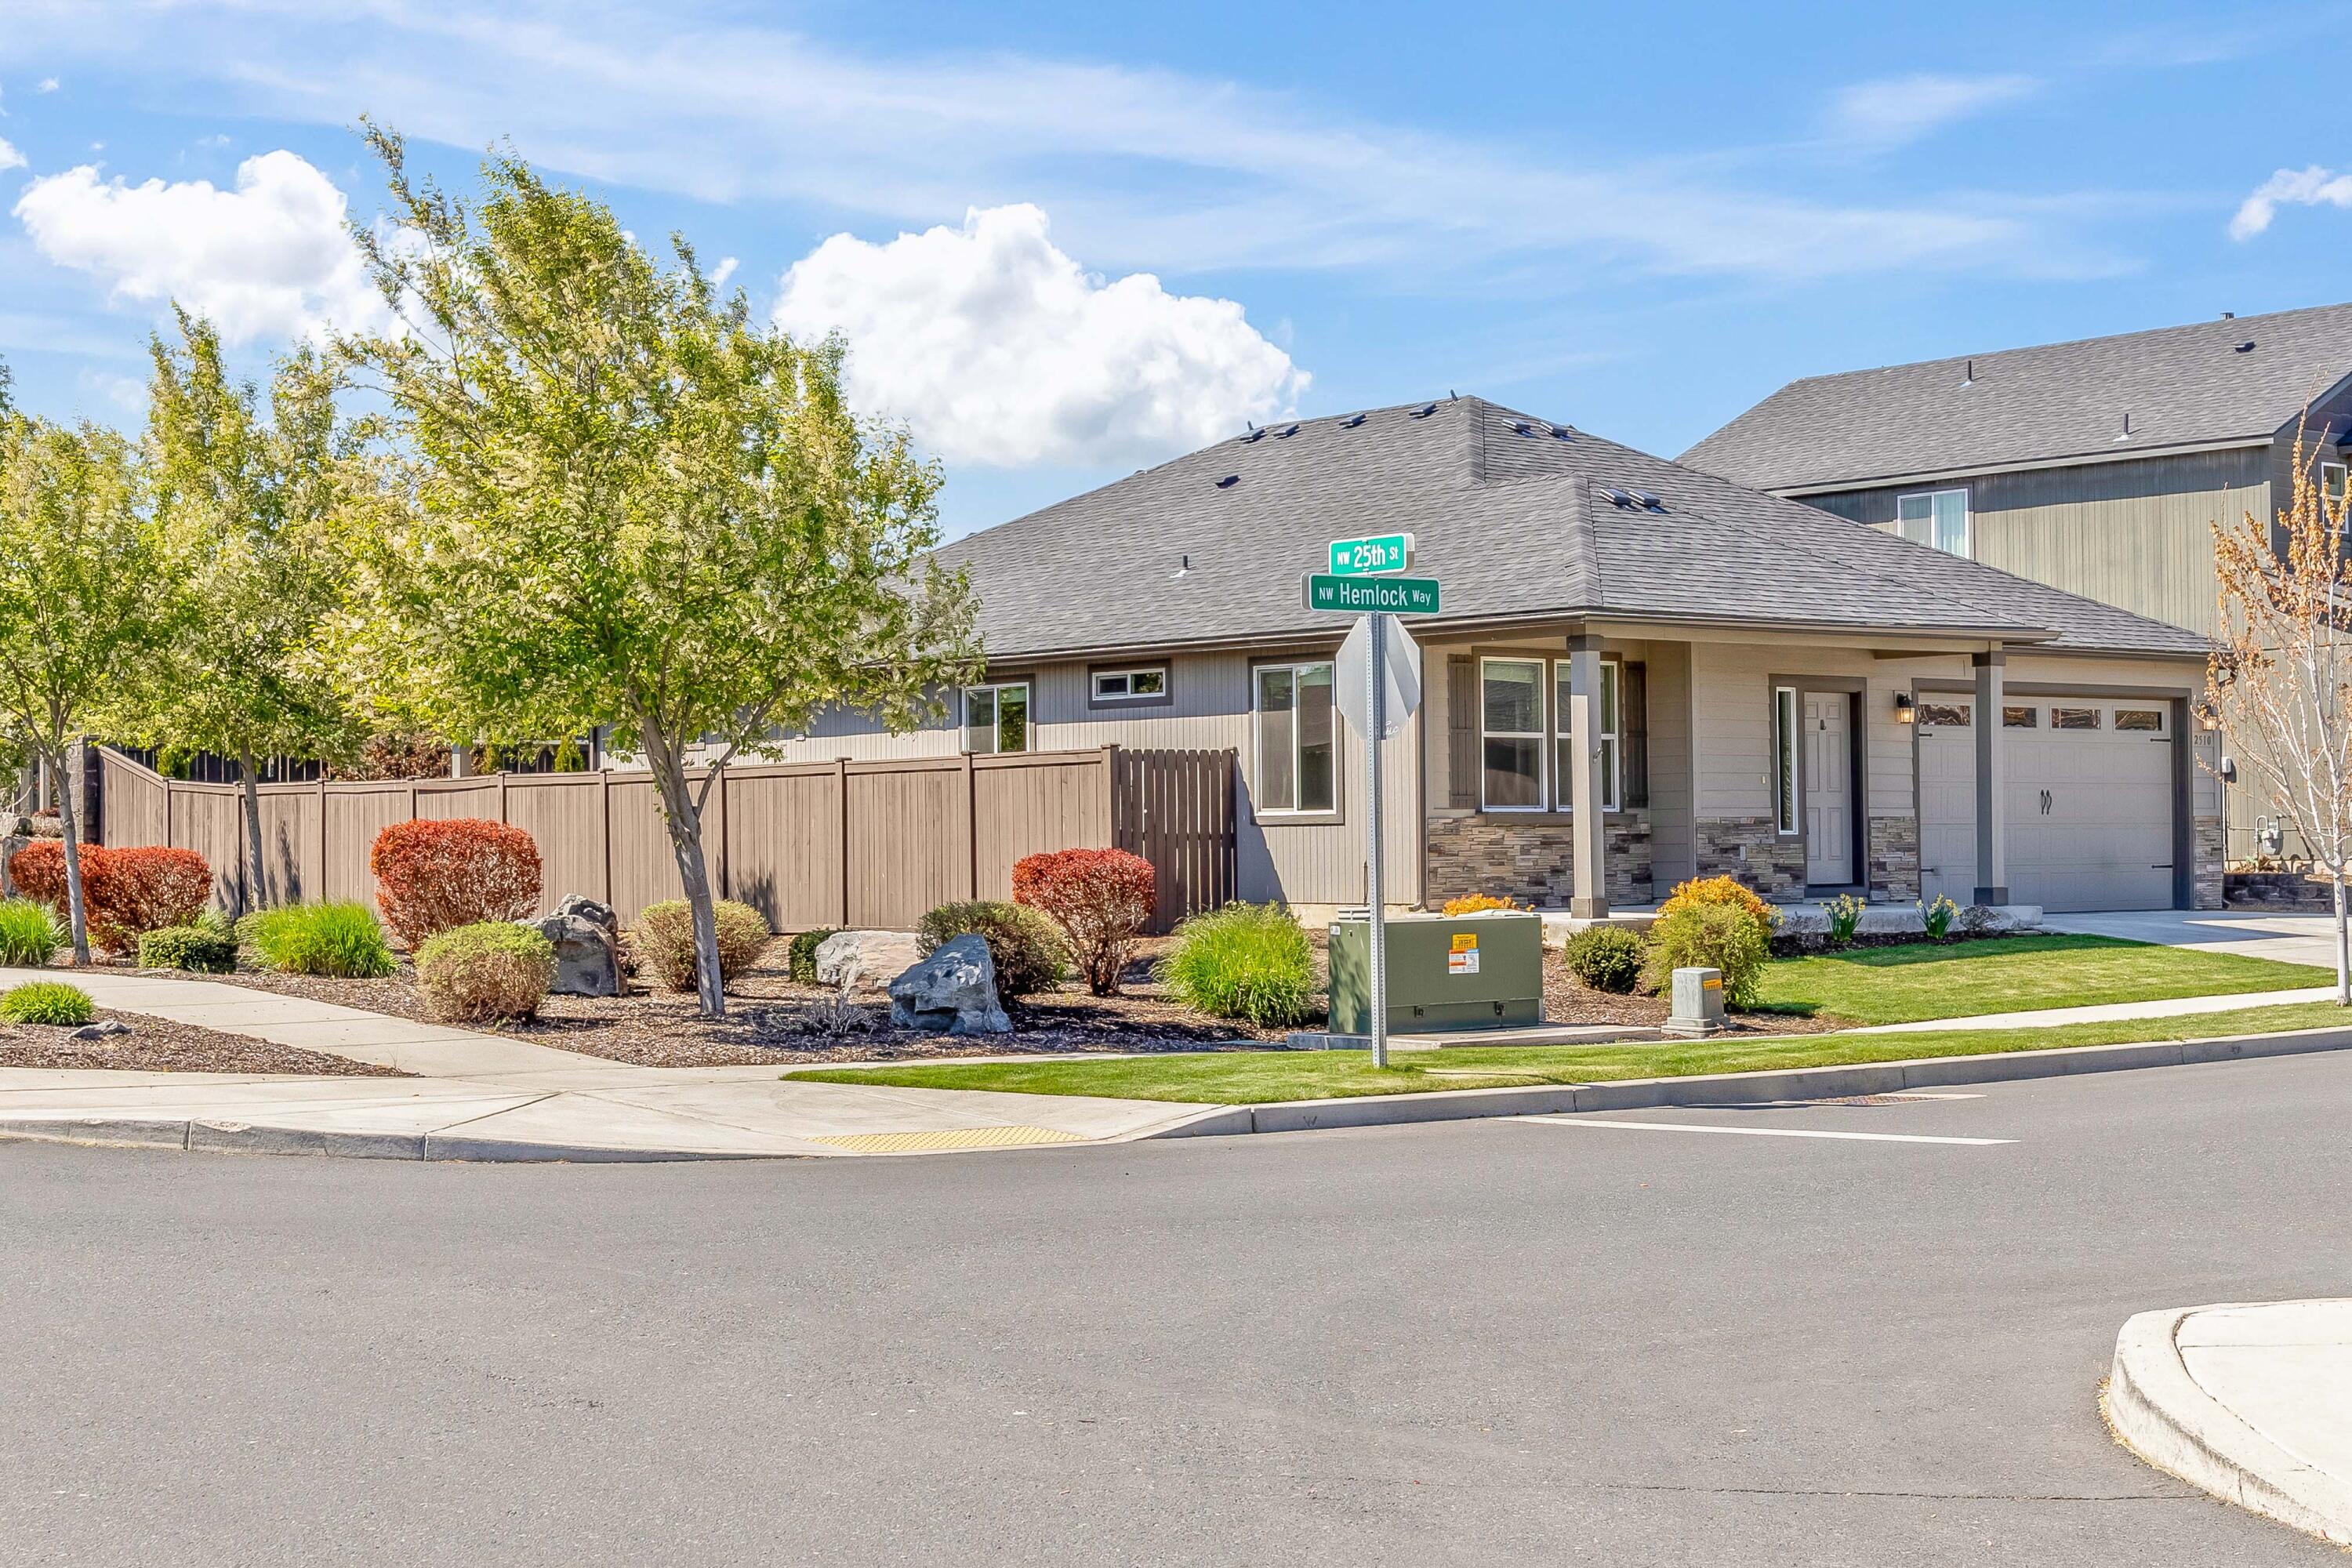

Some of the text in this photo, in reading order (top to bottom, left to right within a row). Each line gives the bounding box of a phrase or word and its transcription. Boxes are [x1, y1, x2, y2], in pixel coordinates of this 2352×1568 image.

[1337, 544, 1399, 568] NW 25th St
[1319, 583, 1432, 606] NW Hemlock Way
[2194, 734, 2212, 746] 2510
